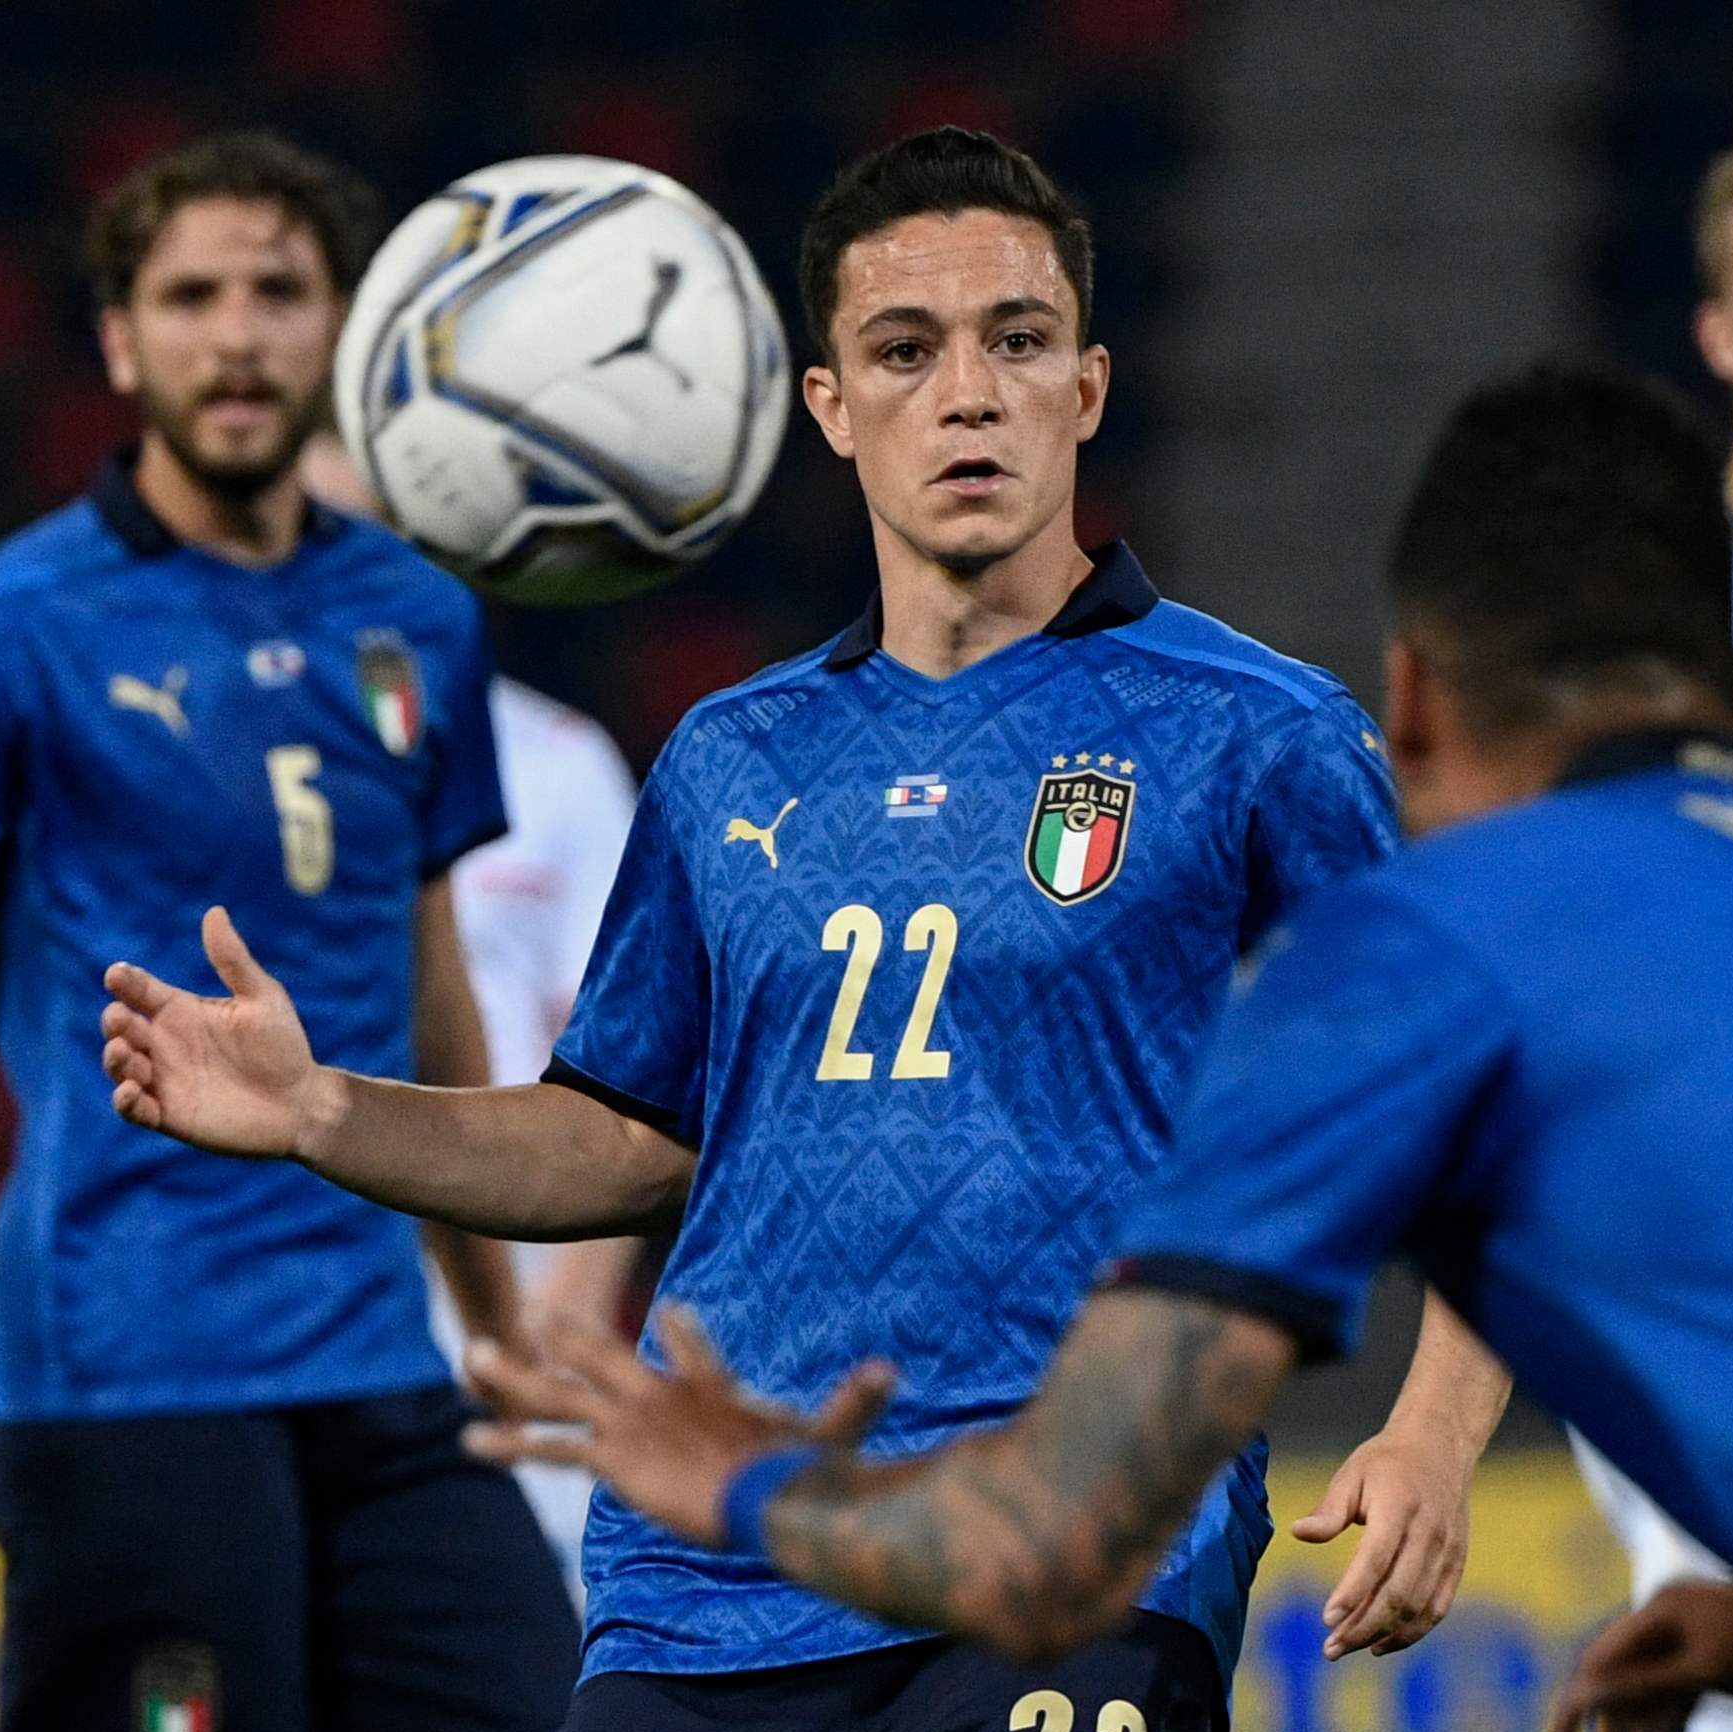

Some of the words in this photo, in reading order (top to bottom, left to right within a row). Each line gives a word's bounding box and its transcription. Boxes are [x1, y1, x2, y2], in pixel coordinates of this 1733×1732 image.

[266, 744, 334, 896] 5
[1046, 783, 1125, 808] ITALIA
[815, 903, 958, 1081] 22
